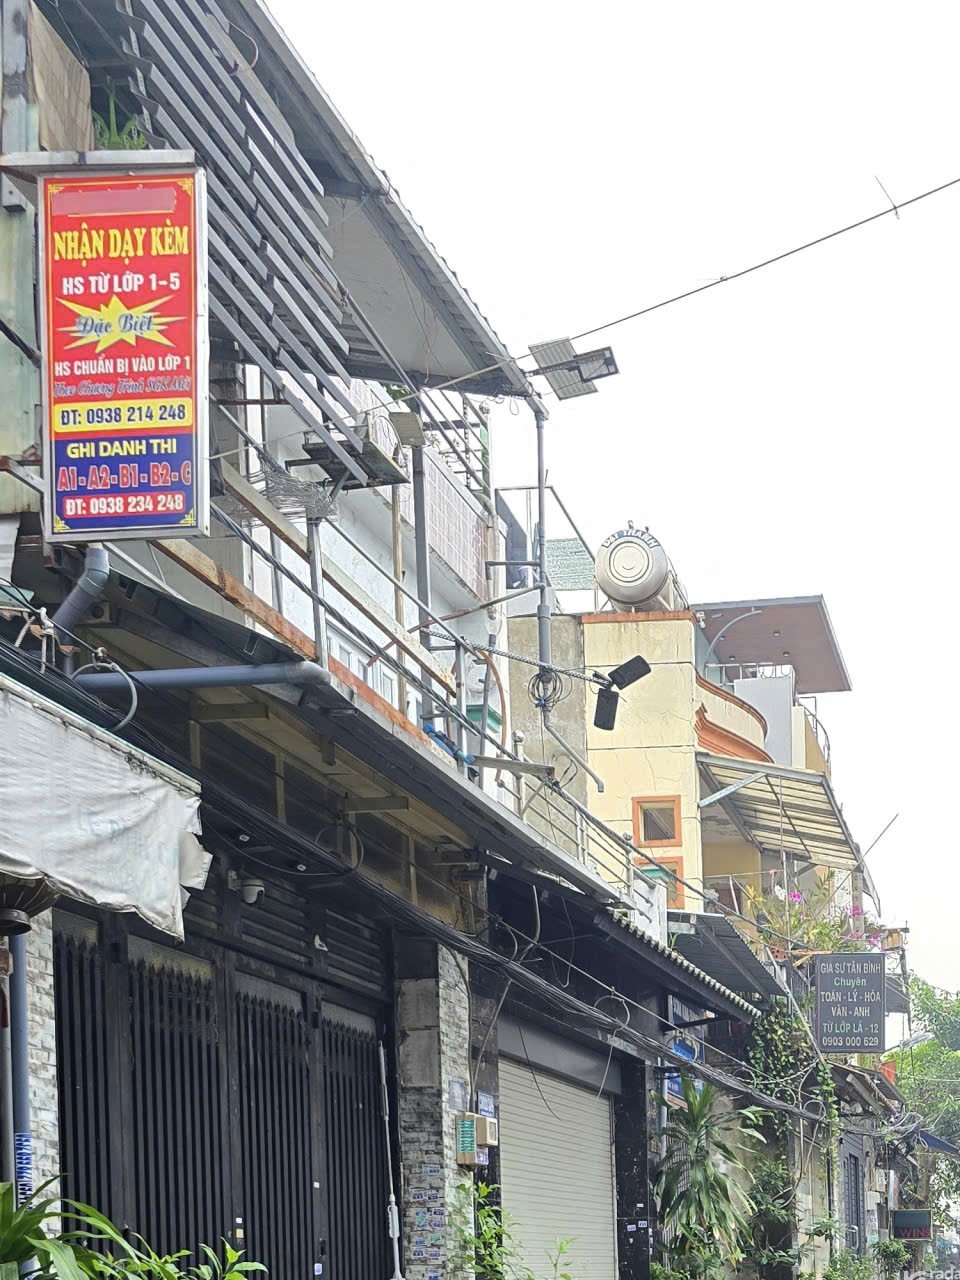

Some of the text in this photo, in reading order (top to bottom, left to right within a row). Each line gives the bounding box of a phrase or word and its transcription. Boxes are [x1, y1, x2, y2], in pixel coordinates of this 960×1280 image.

[53, 217, 189, 268] NHẬN DẠY KÈM
[62, 276, 85, 296] HS
[88, 271, 111, 294] TỪ
[113, 270, 144, 292] LỚP
[54, 352, 191, 377] HS CHUẨN BỊ VÀO LỚP 1
[61, 404, 186, 426] ĐT: 0938 214 248
[66, 438, 177, 459] GHI DANH THI
[65, 494, 184, 516] ĐT: 0938 234 248
[820, 960, 881, 974] GIA SƯ TÂN BÌNH
[834, 976, 867, 989] Chuyên
[820, 989, 842, 1002] TOÁN
[848, 989, 858, 1002] LÝ
[864, 989, 881, 1002] HÓA
[831, 1004, 848, 1017] VĂN
[853, 1006, 870, 1017] ANH
[823, 1020, 834, 1033] TỪ
[835, 1021, 851, 1033] LỚP
[853, 1021, 863, 1033] LÁ
[870, 1023, 879, 1033] 12
[822, 1036, 879, 1046] 0903 000 629
